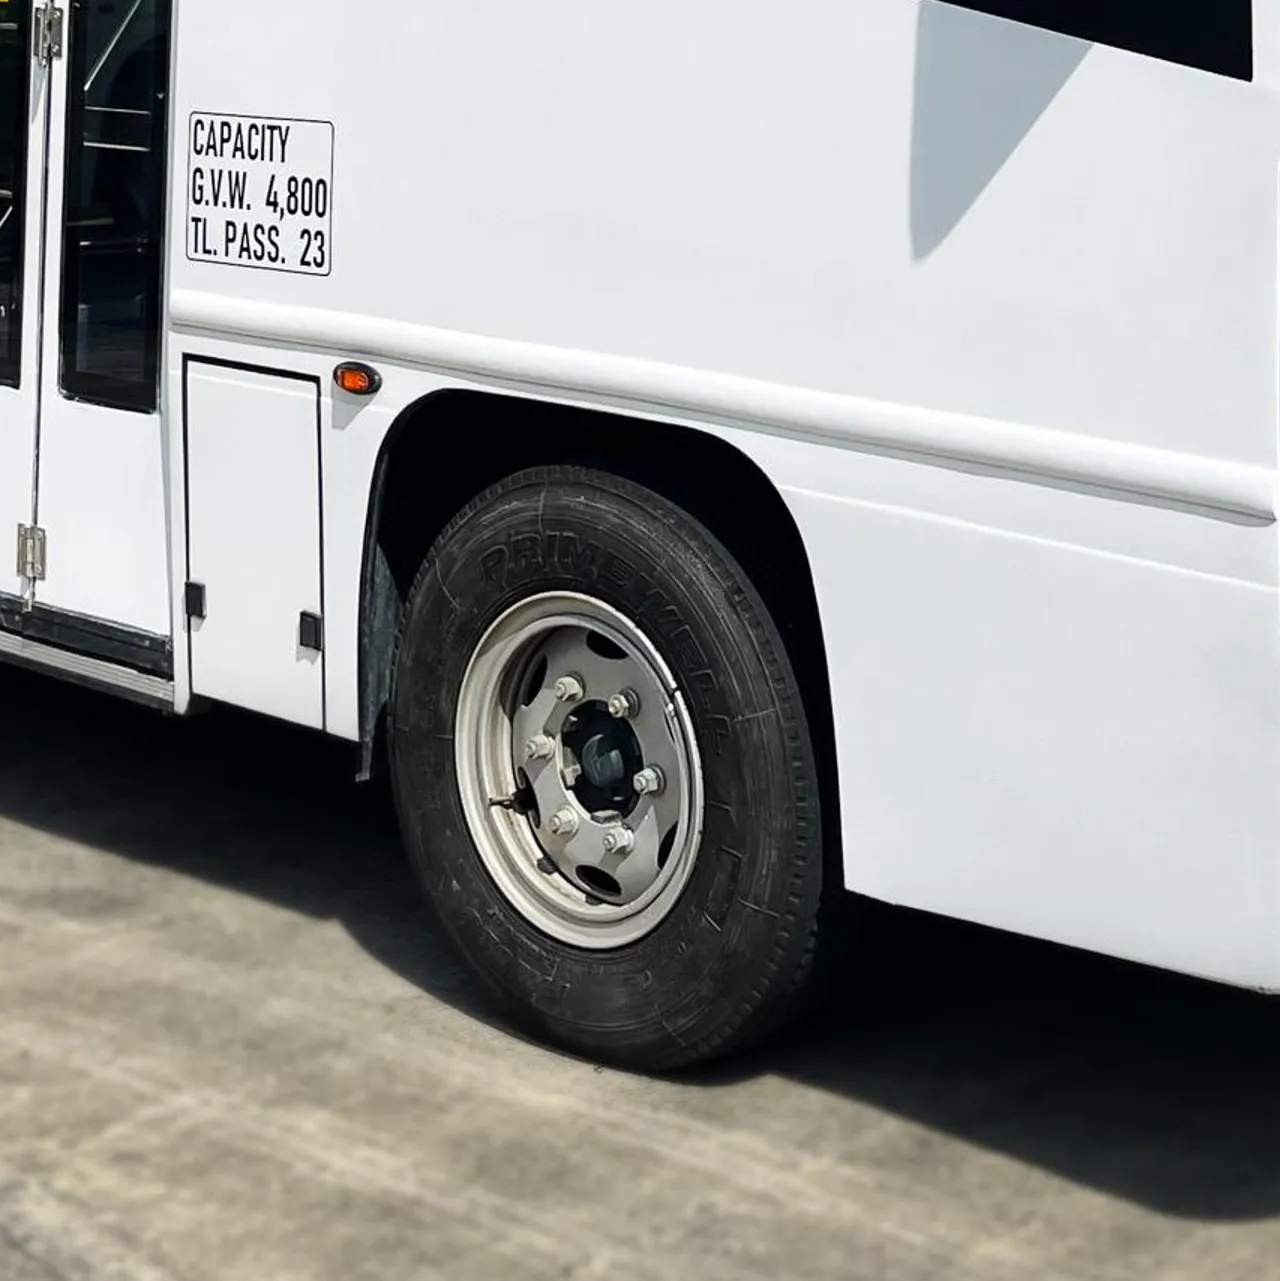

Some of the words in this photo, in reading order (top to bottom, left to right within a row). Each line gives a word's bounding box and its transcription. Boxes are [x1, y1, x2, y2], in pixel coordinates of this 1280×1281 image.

[193, 119, 290, 163] CAPACITY
[192, 167, 251, 211] G.V.W.
[265, 174, 328, 222] 4,800
[191, 216, 218, 256] TL.
[224, 220, 286, 264] PASS.
[299, 228, 326, 269] 23
